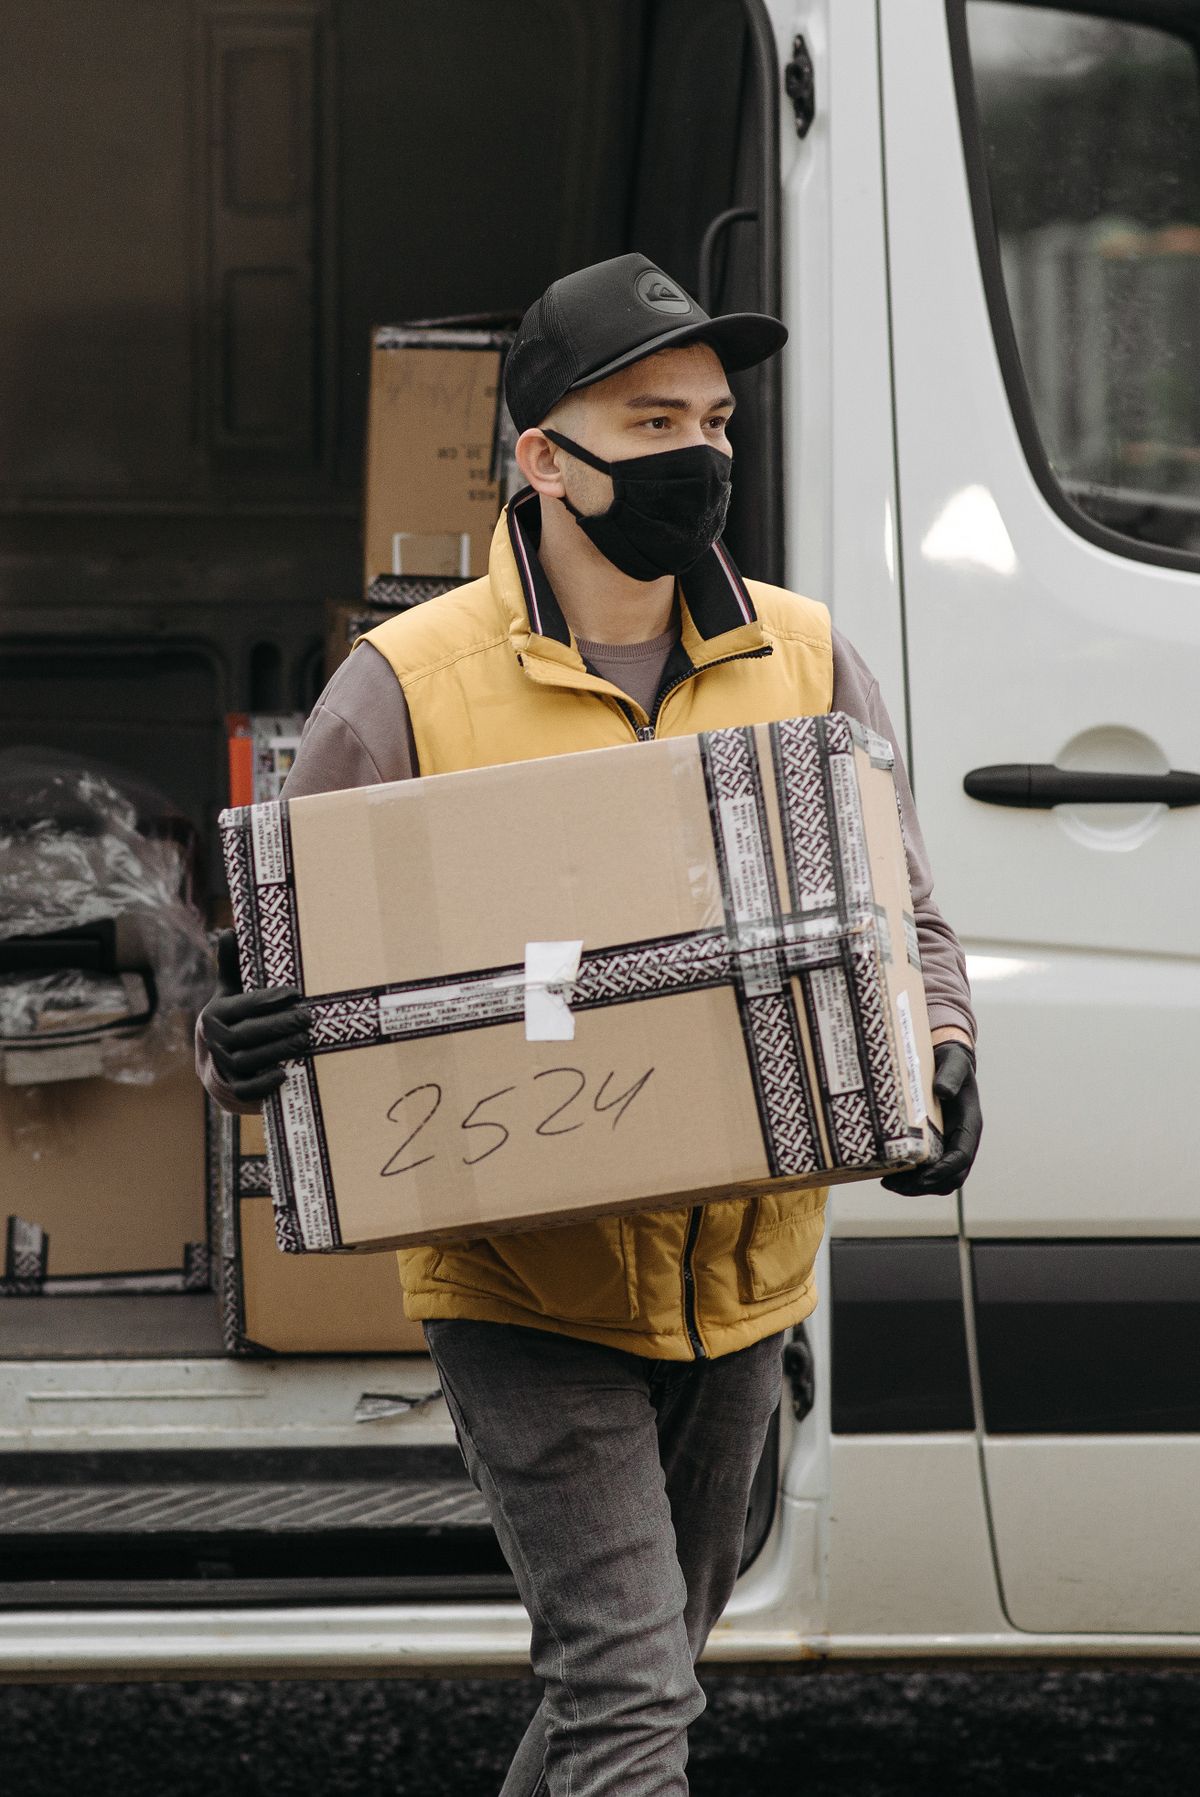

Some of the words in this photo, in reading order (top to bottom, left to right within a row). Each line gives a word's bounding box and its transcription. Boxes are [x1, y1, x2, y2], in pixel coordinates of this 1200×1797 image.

[272, 823, 280, 848] SPISAĆ
[734, 826, 744, 854] TAŚMY
[847, 811, 855, 837] TAŚMY
[257, 818, 266, 866] PRZYPADKU
[266, 831, 275, 878] ZAKLEJENIA
[274, 850, 282, 877] NALEŻY
[385, 1020, 411, 1032] NALEŻY
[414, 1016, 439, 1026] SPISAĆ
[441, 1009, 479, 1022] PROTOKÓŁ
[830, 1024, 844, 1075] PRZYPADKU
[286, 1097, 296, 1125] TAŚMY
[296, 1105, 305, 1125] INNĄ
[303, 1106, 316, 1148] OBECNOŚCI
[380, 1067, 655, 1177] 2524
[291, 1130, 306, 1189] USZKODZENIA
[300, 1131, 311, 1171] FIRMOWEJ
[306, 1177, 316, 1202] TAŚMY
[311, 1159, 324, 1198] PROTOKÓŁ
[301, 1195, 315, 1244] PRZYPADKU
[317, 1200, 328, 1225] SPISAĆ
